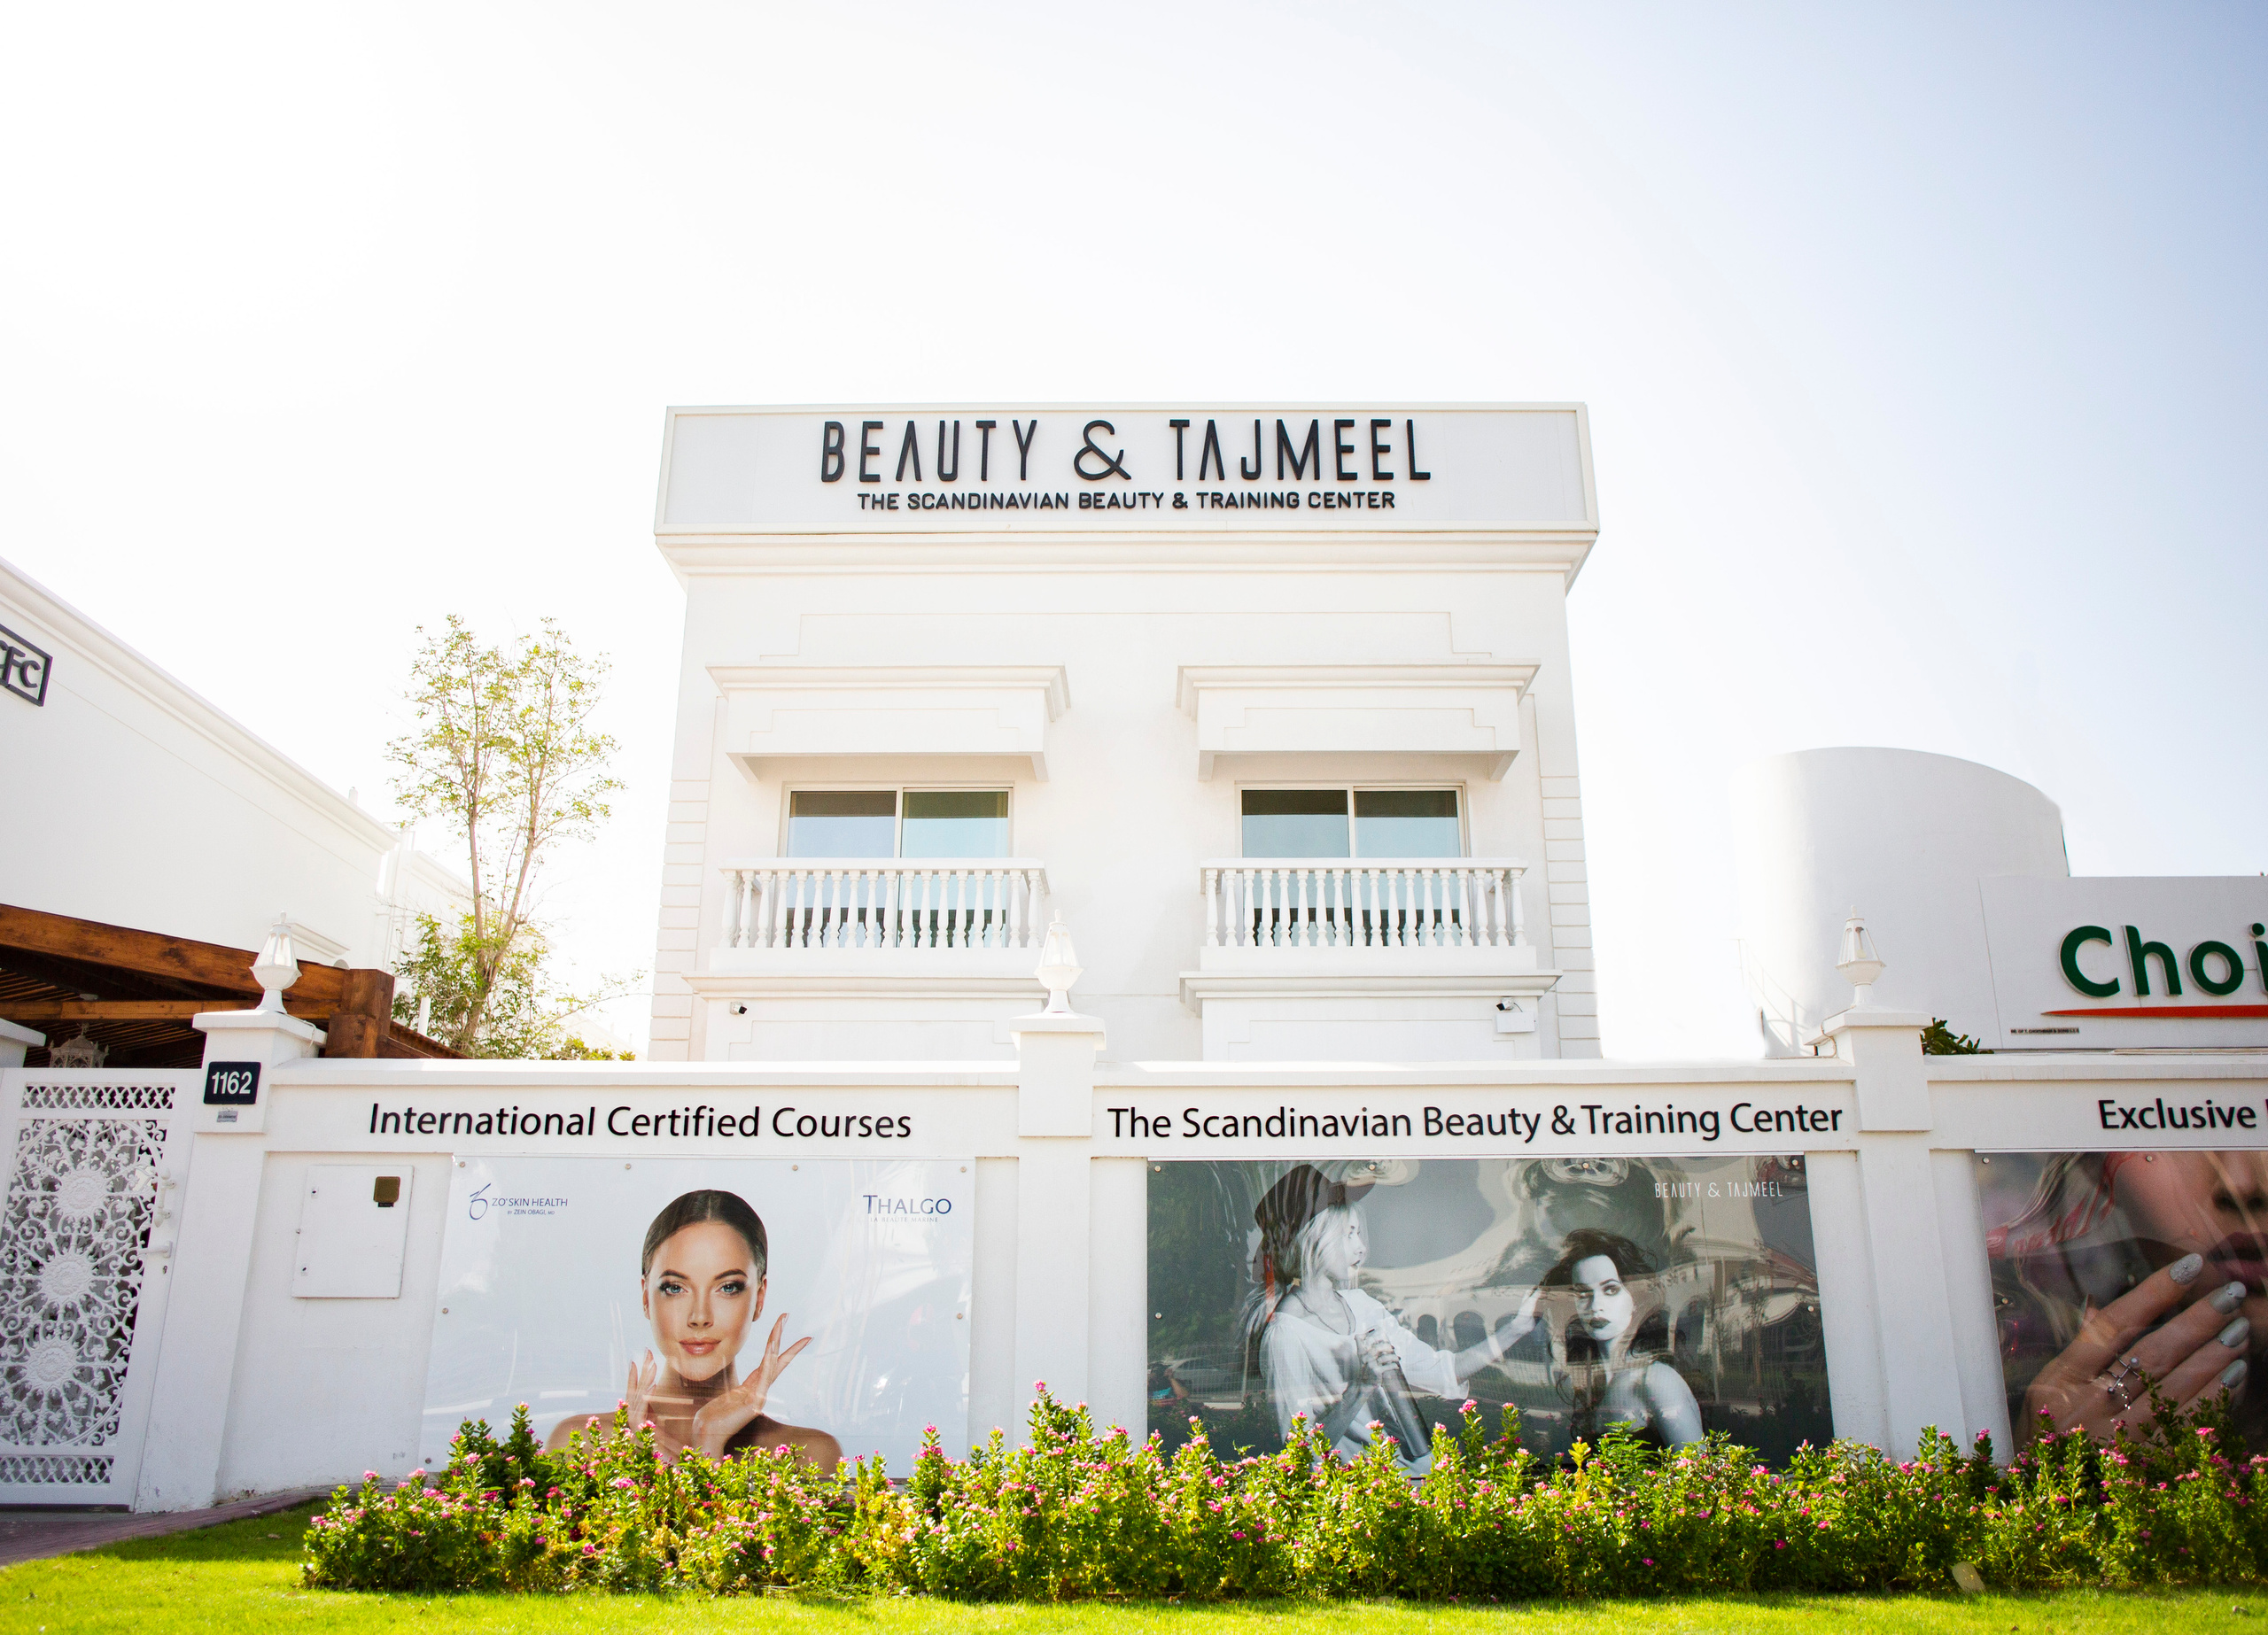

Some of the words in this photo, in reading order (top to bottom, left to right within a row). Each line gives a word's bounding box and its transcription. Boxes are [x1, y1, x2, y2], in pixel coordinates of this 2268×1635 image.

[821, 420, 1037, 482] BEAUTY
[1074, 421, 1131, 481] &
[1169, 420, 1430, 481] TAJMEEL
[858, 493, 899, 509] THE
[908, 493, 1068, 509] SCANDINAVIAN
[1079, 492, 1163, 509] BEAUTY
[1173, 492, 1188, 508] &
[1197, 492, 1299, 508] TRAINING
[1309, 492, 1394, 508] CENTER
[212, 1071, 252, 1095] 1162
[370, 1104, 594, 1135] International
[608, 1105, 759, 1136] Certified
[773, 1107, 911, 1137] Courses
[1107, 1107, 1171, 1137] The
[1184, 1106, 1410, 1137] Scandinavian
[1425, 1107, 1541, 1143] Beauty
[1552, 1105, 1574, 1135] &
[1581, 1104, 1720, 1141] Training
[1731, 1103, 1843, 1134] Center
[2098, 1097, 2257, 1129] Exclusive
[1655, 1182, 1700, 1198] BEAUTY
[1708, 1182, 1720, 1197] &
[1728, 1182, 1783, 1197] TAJMEEL
[863, 1195, 951, 1214] THALGO
